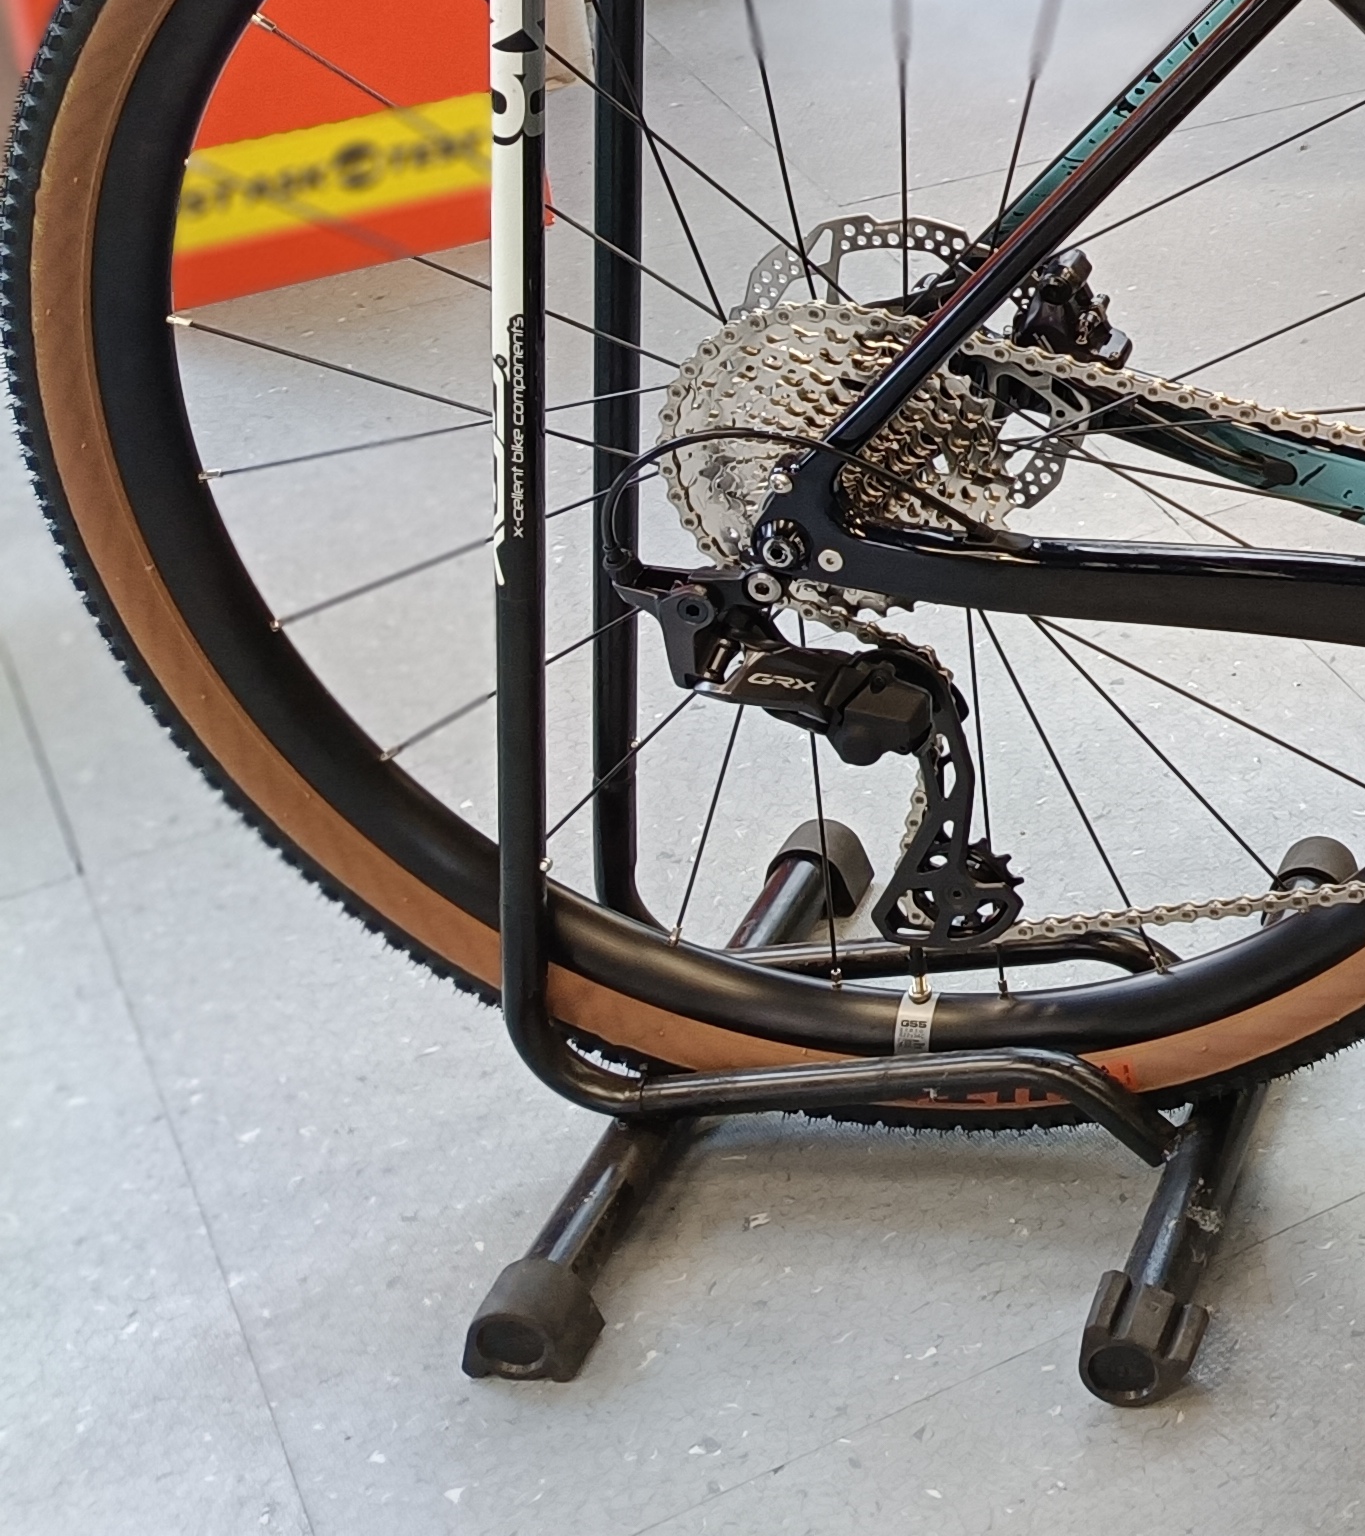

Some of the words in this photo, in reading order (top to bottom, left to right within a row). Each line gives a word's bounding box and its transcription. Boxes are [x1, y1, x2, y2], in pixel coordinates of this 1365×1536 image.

[511, 316, 526, 426] components
[511, 429, 525, 463] bike
[747, 673, 816, 693] GRX
